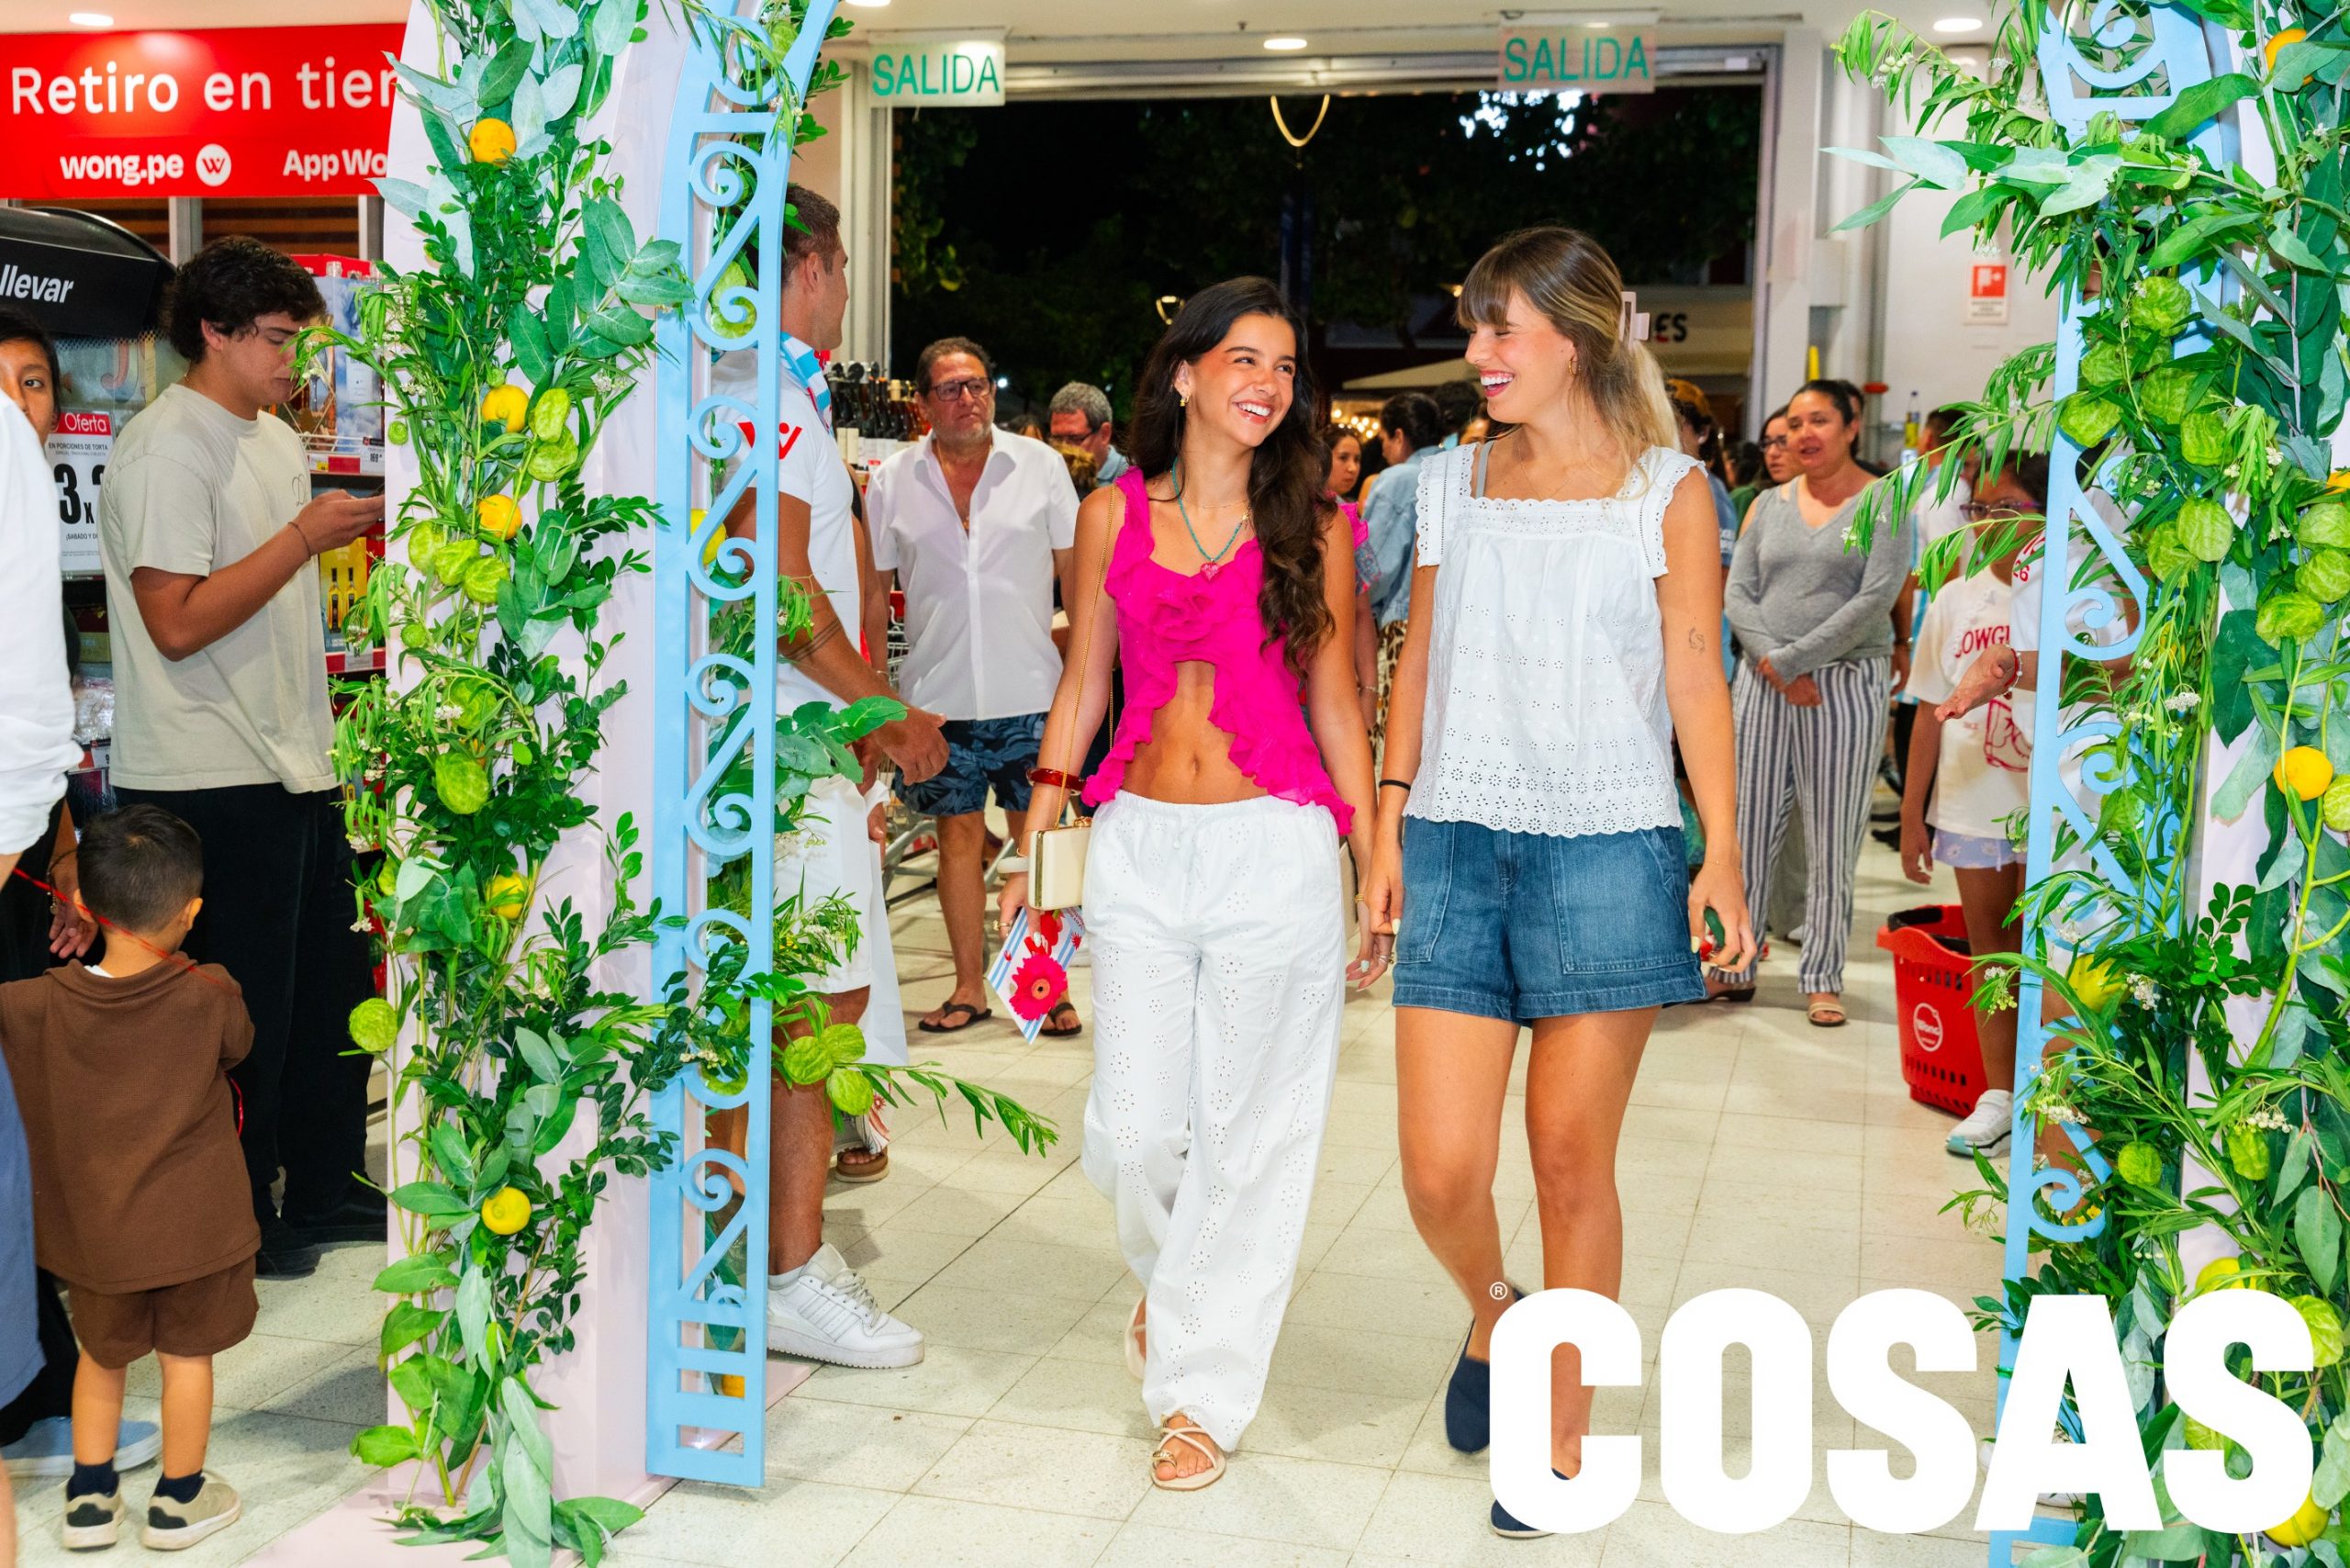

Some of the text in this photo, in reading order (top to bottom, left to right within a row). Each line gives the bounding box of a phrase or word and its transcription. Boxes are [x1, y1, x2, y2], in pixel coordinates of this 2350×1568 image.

[872, 52, 1002, 96] SALIDA
[1503, 35, 1650, 82] SALIDA
[12, 61, 179, 115] Retiro
[204, 72, 272, 111] en
[61, 152, 185, 186] wong.pe
[283, 150, 340, 181] App
[0, 263, 74, 304] llevar
[64, 412, 107, 433] Oferta
[56, 442, 84, 451] PORCIONES
